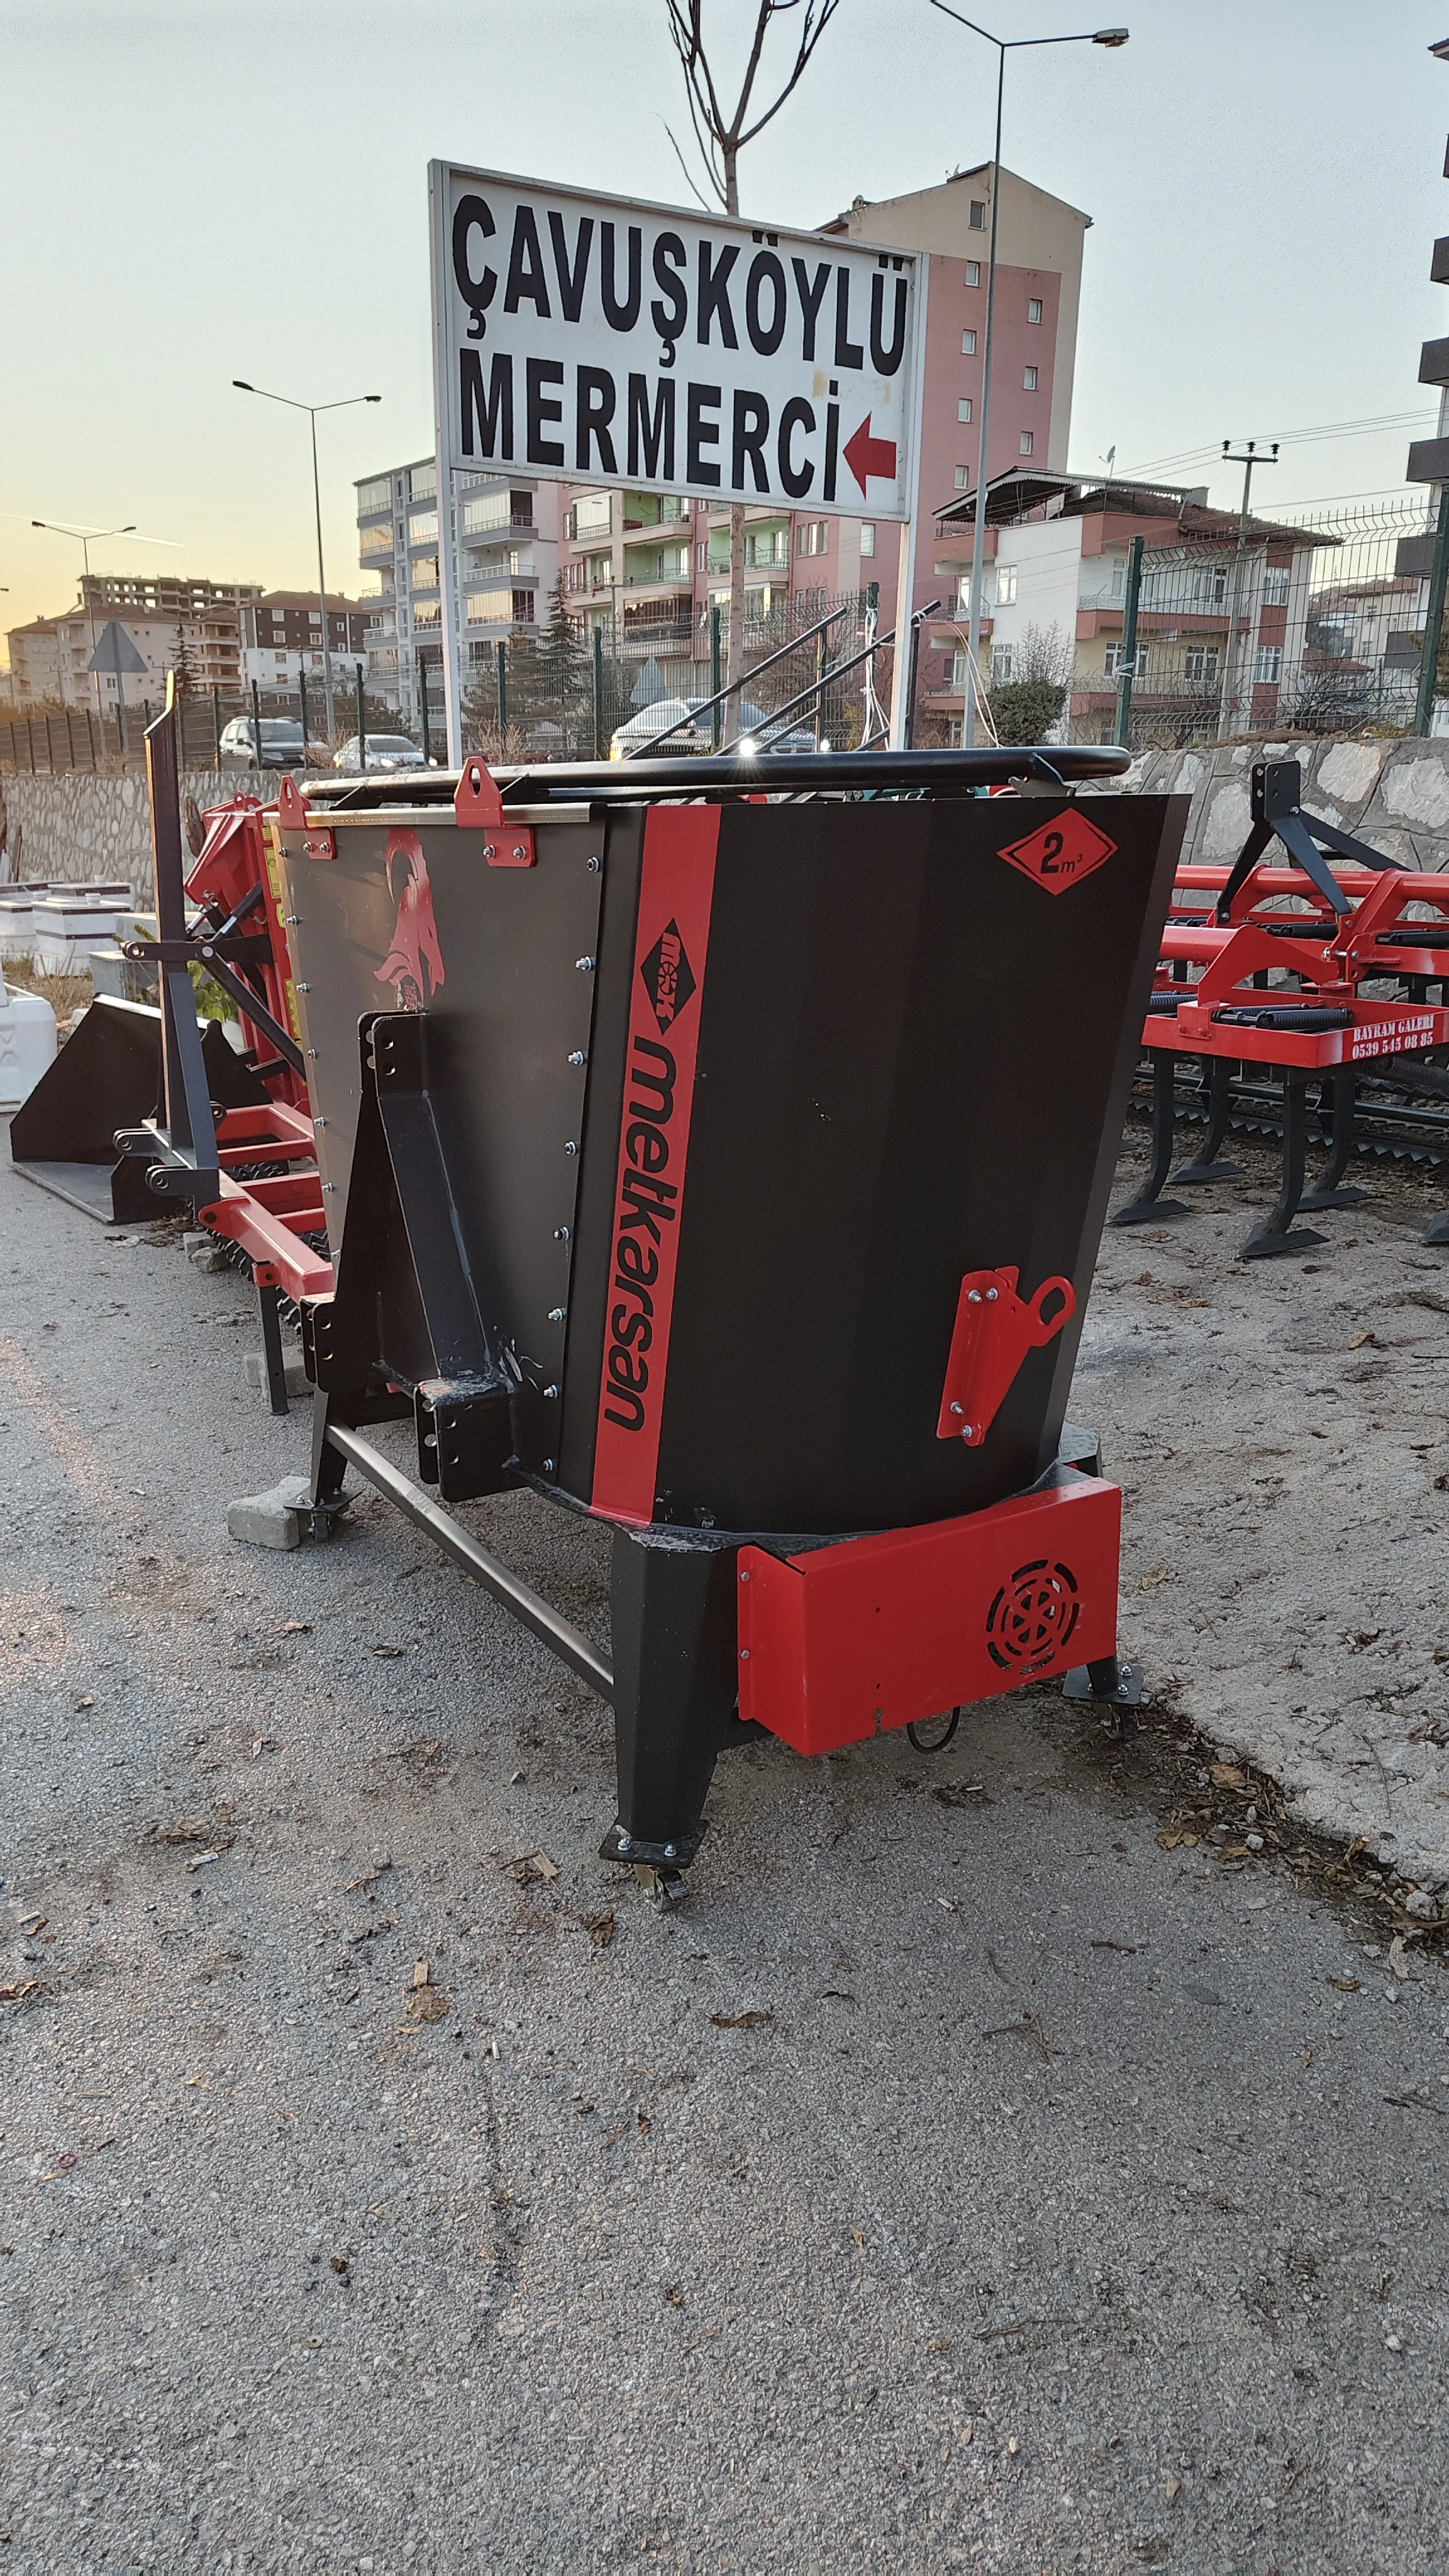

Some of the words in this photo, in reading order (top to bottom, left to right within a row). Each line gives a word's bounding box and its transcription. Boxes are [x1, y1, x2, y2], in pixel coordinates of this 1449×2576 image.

[452, 194, 908, 376] ÇAVUŞKÖYLÜ
[459, 348, 838, 501] MERMERCİ
[1353, 1023, 1396, 1041] BAYRAM
[1353, 1042, 1379, 1059] 0539
[1382, 1036, 1402, 1053] 545
[1404, 1035, 1418, 1049] 08
[1421, 1032, 1433, 1046] 85
[604, 1035, 678, 1431] metkarsan
